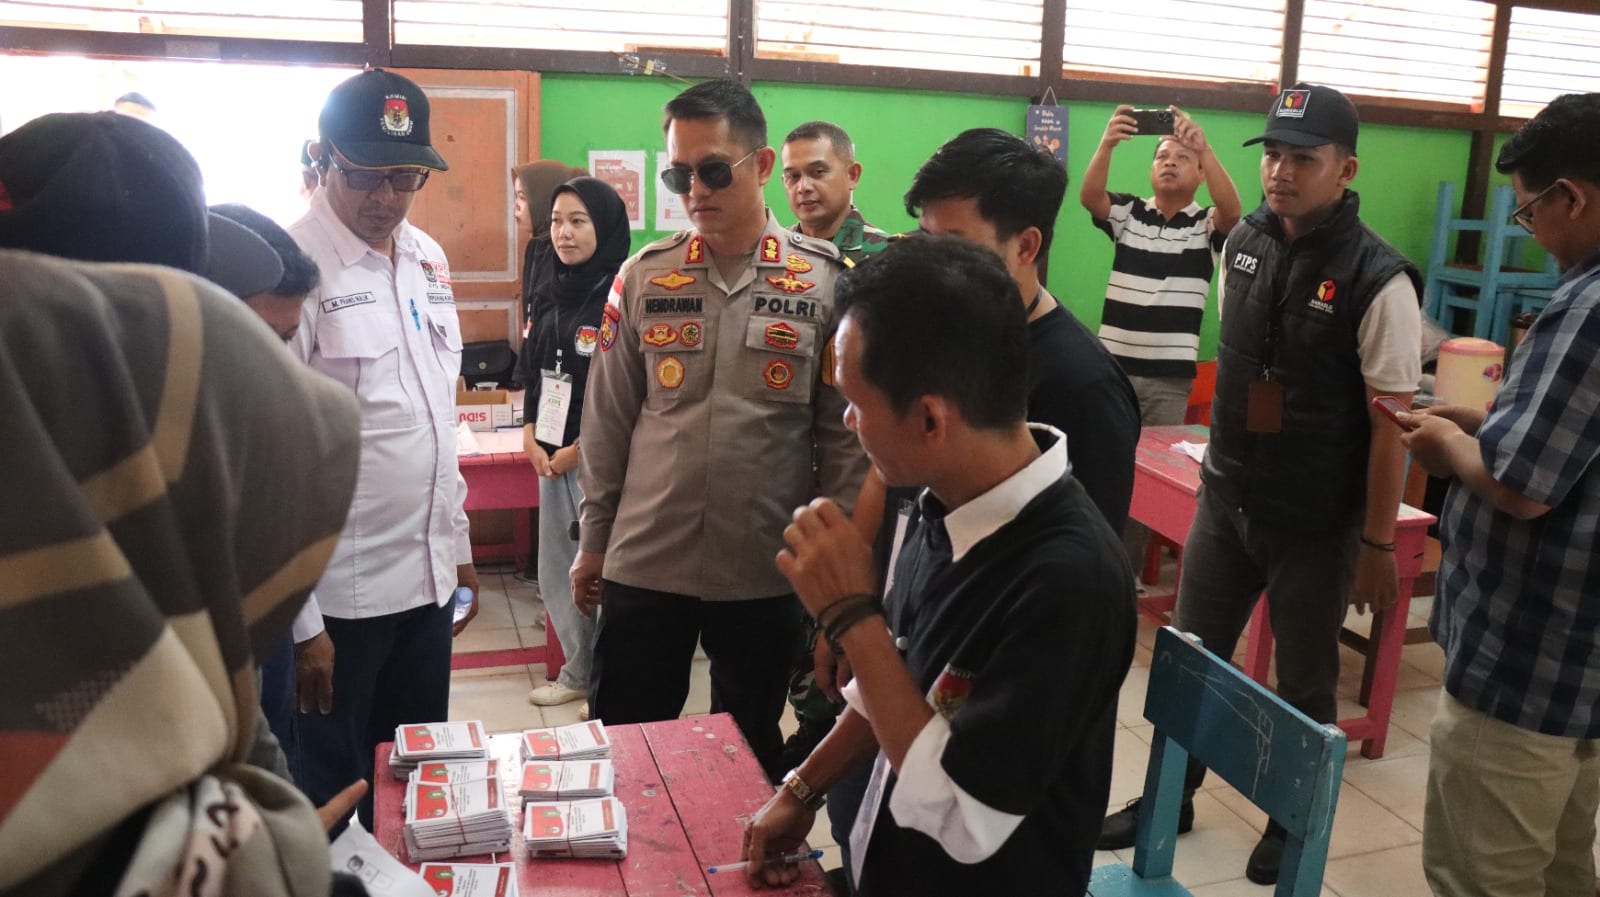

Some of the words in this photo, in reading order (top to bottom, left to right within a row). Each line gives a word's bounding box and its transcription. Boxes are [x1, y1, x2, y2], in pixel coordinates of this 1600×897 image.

[1234, 252, 1258, 270] PTPS
[645, 297, 703, 314] HENDRAWAN
[754, 296, 816, 317] POLRI
